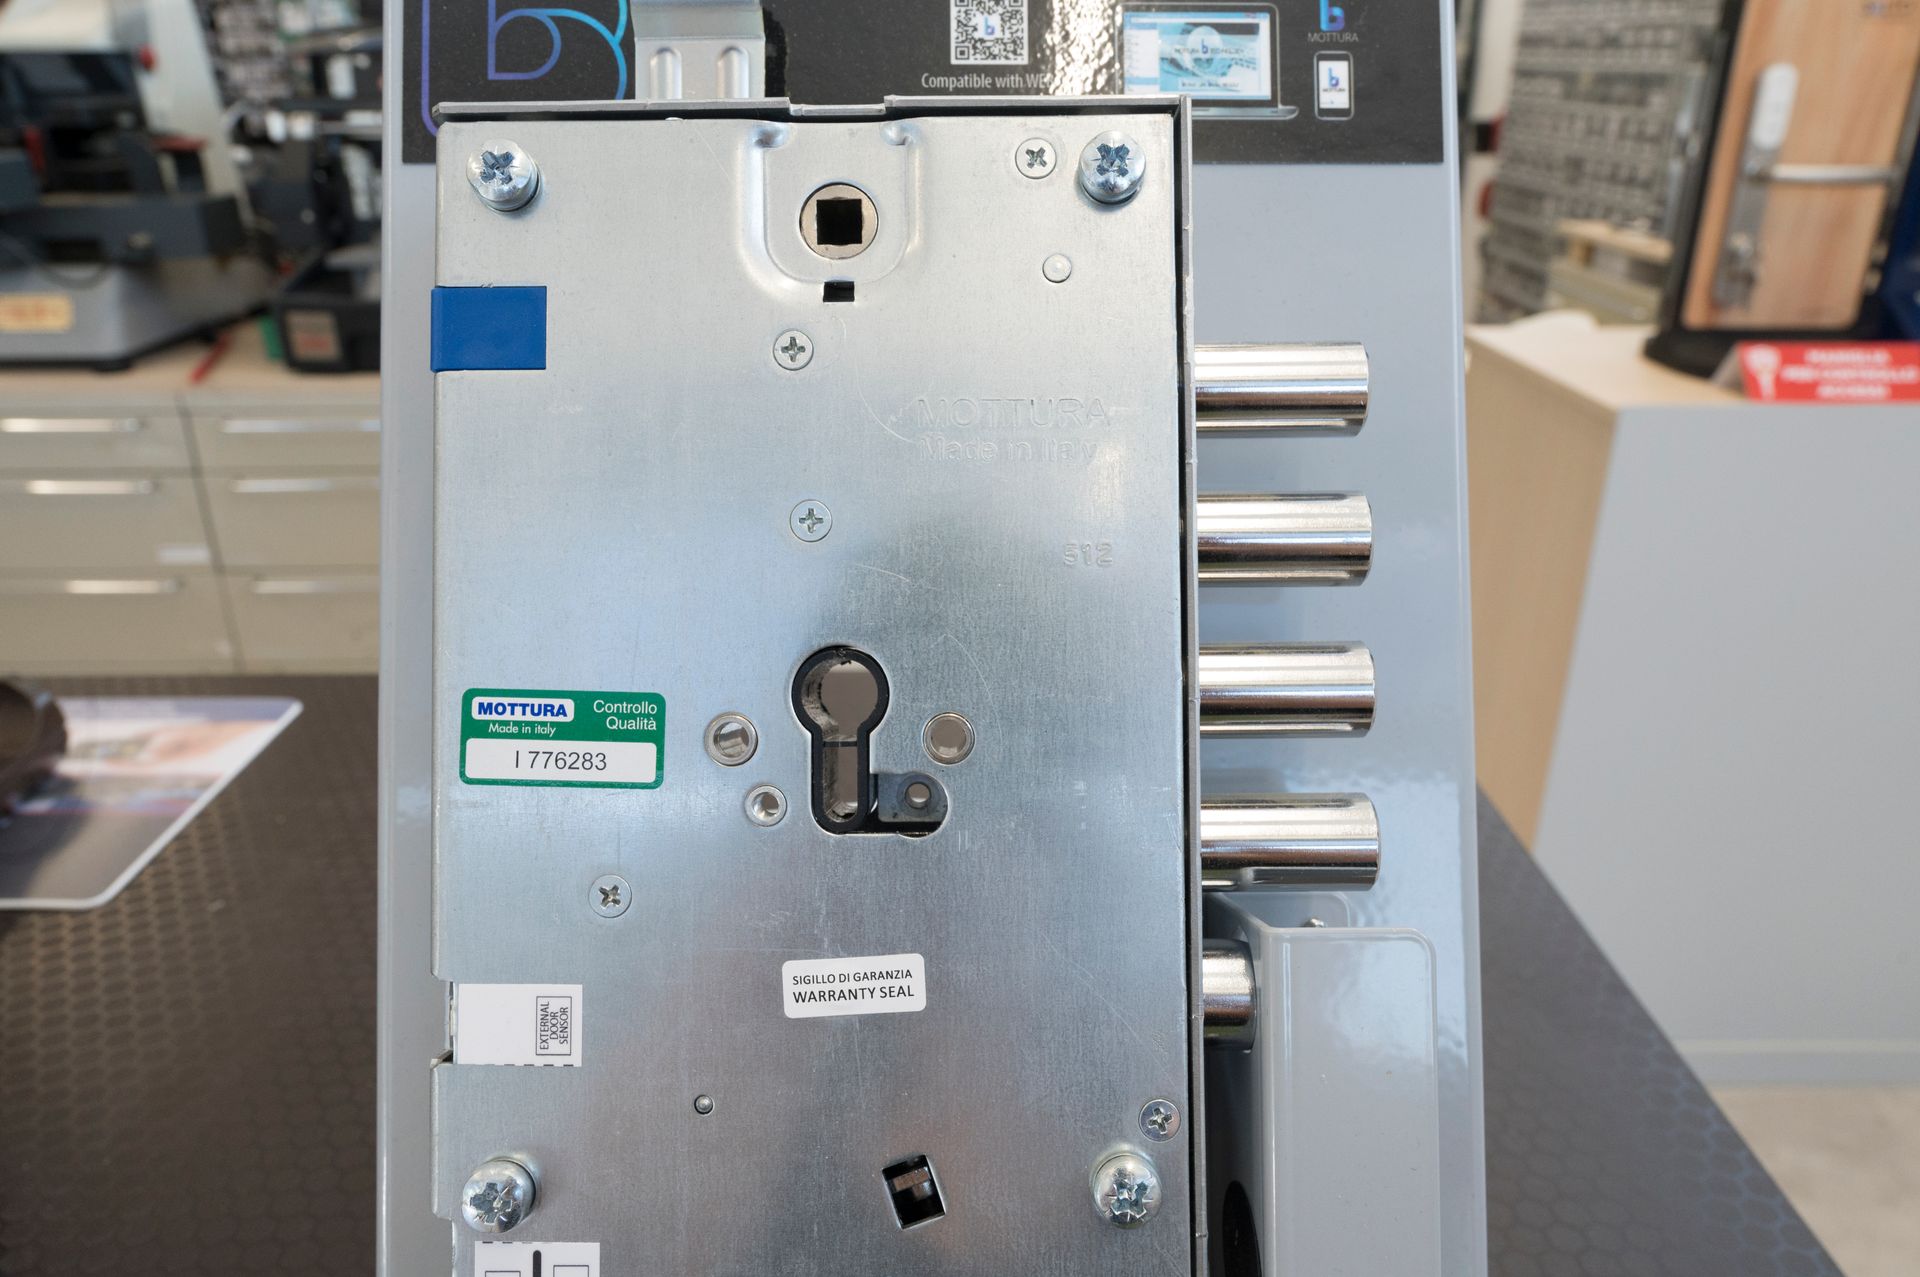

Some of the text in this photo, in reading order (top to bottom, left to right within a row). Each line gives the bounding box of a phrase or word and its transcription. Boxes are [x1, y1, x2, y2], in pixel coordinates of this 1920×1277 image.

[1307, 32, 1359, 42] MOTTURA
[921, 73, 992, 92] Compatible
[995, 74, 1023, 88] with
[917, 398, 1111, 428] MOTTURA
[917, 437, 998, 463] Made
[1007, 438, 1032, 463] in
[477, 702, 568, 717] MOTTURA
[593, 700, 658, 714] Controllo
[488, 723, 556, 737] Made in italy
[606, 716, 657, 731] Qualità
[528, 751, 608, 771] 776283
[792, 969, 913, 986] SIGILLO DI GARANZIA
[793, 984, 915, 1003] WARRANTY SEAL
[540, 1001, 550, 1050] EXTERNAL
[550, 1011, 559, 1039] DOOR
[559, 1007, 569, 1045] SENSOR
